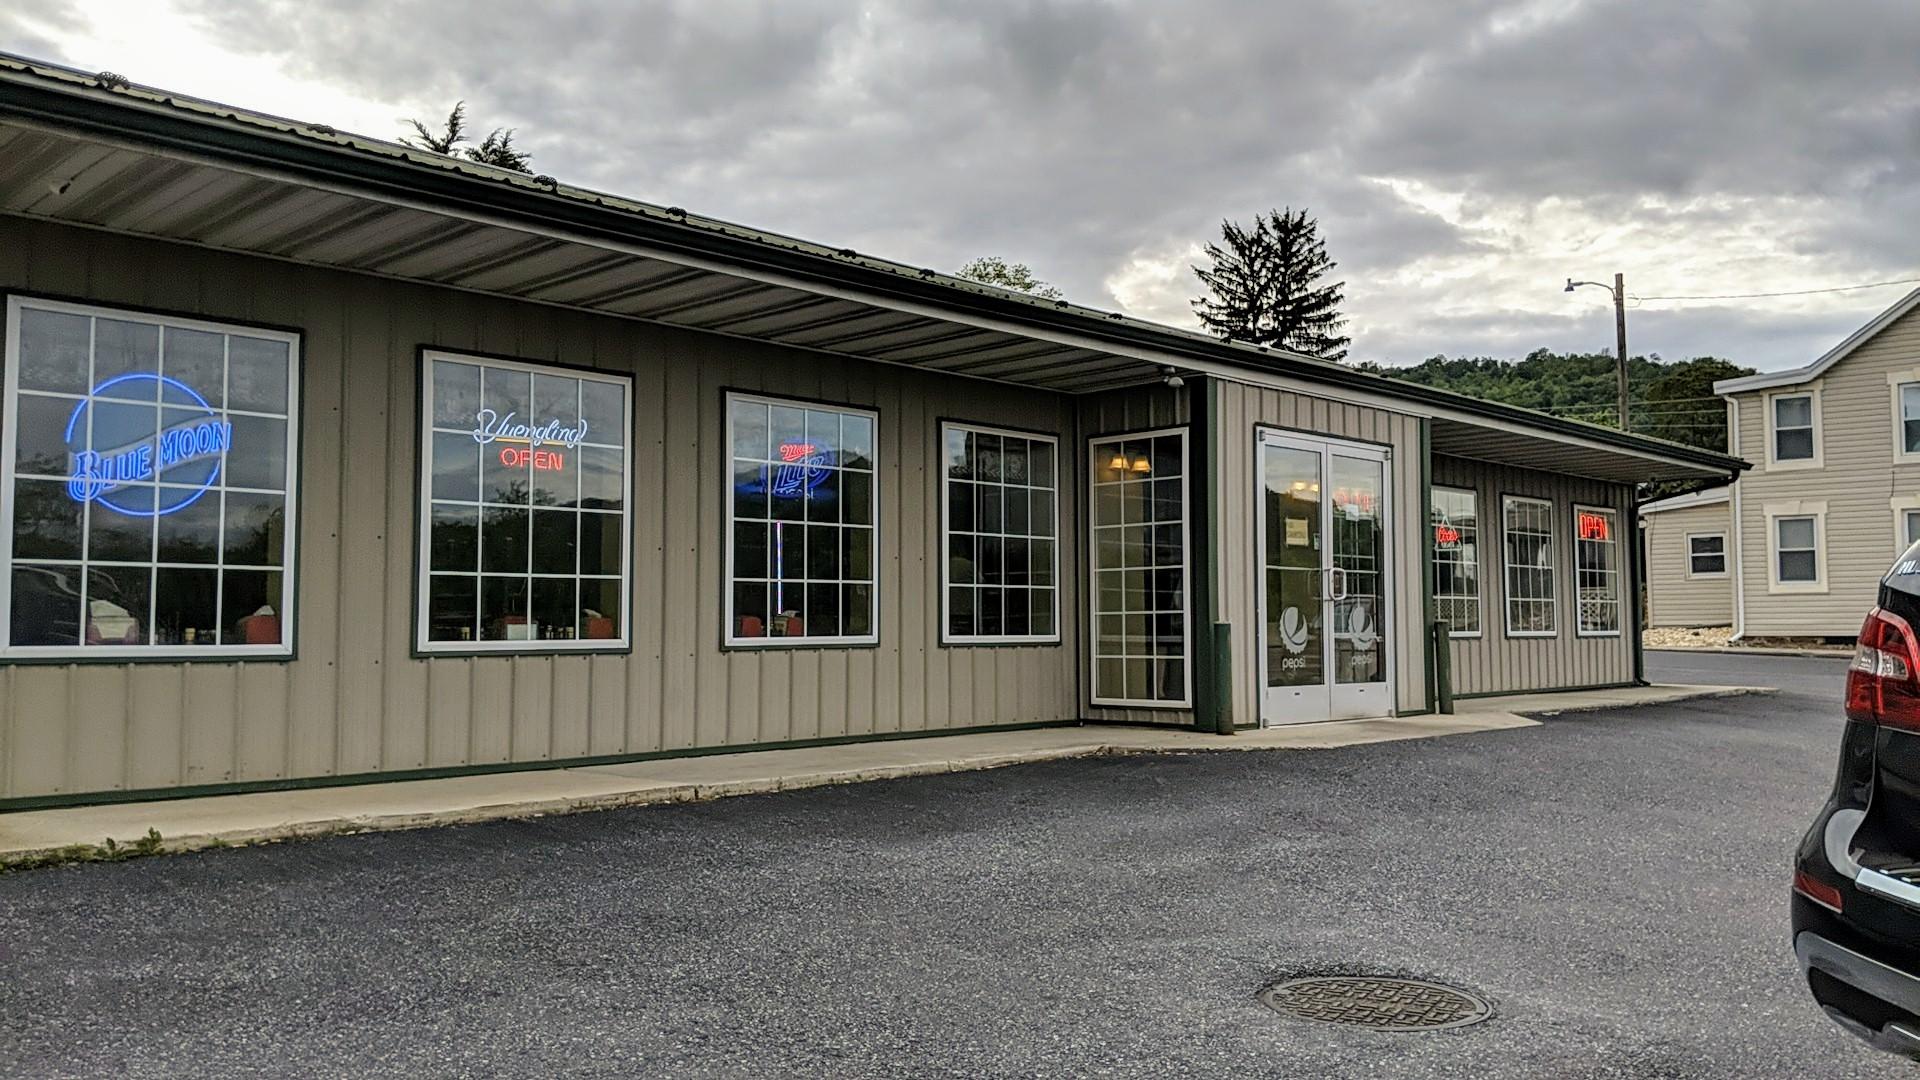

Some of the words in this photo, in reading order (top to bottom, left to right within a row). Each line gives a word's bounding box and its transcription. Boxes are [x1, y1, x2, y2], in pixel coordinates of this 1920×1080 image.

[473, 409, 588, 449] Yuengling
[156, 421, 232, 470] MOON
[500, 447, 564, 471] OPEN
[1579, 514, 1608, 540] OPEN
[1282, 656, 1306, 671] pepsi
